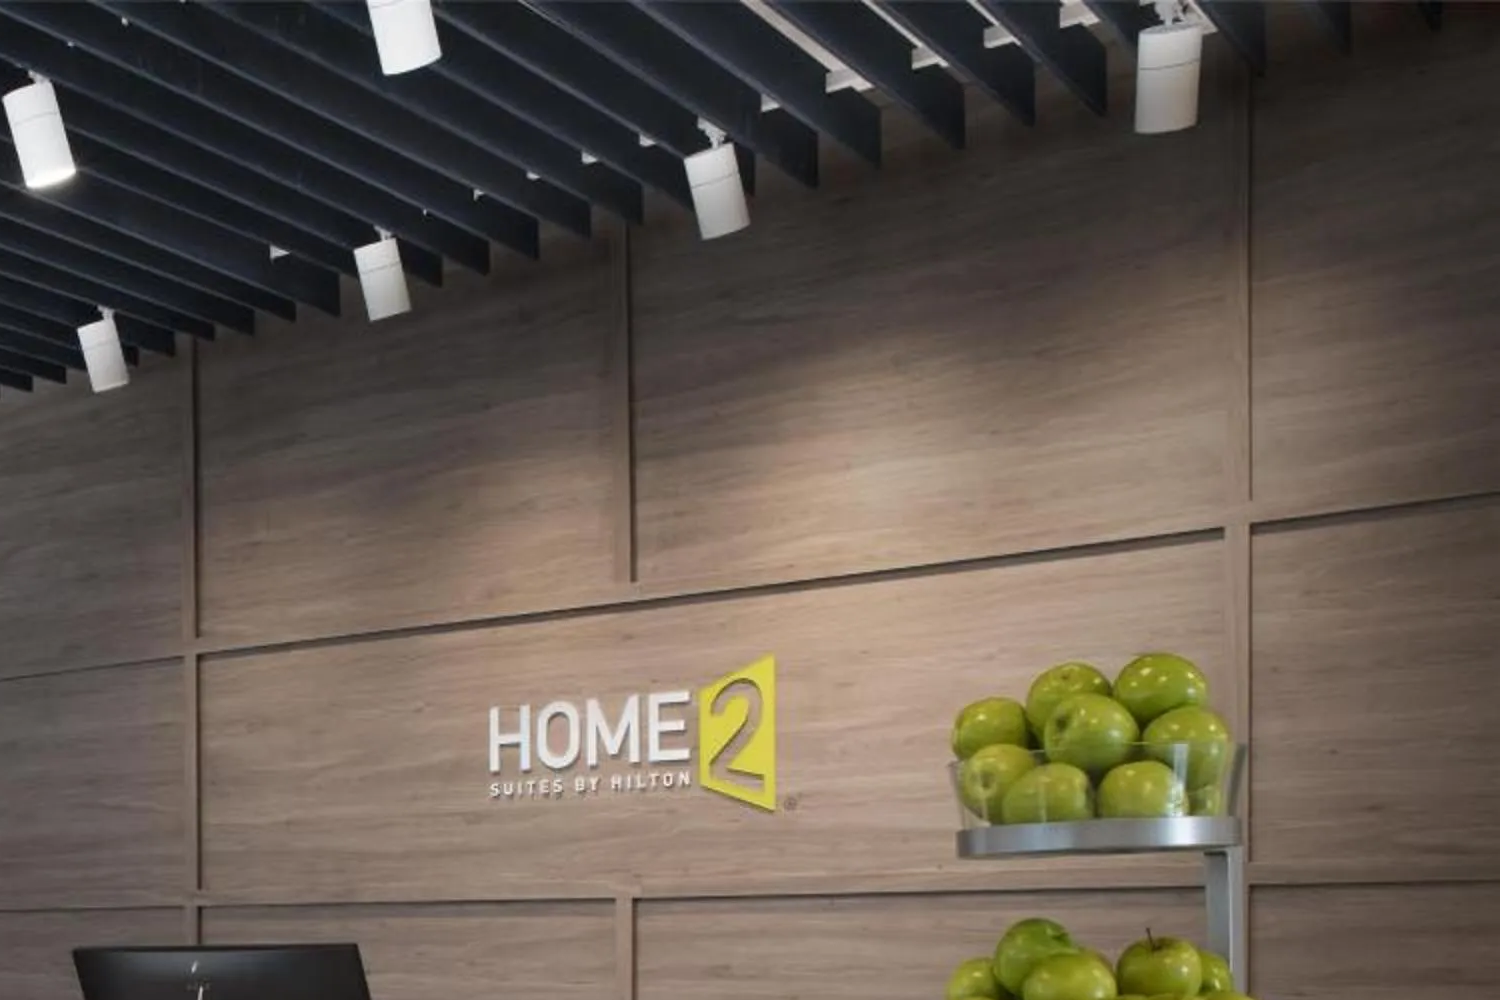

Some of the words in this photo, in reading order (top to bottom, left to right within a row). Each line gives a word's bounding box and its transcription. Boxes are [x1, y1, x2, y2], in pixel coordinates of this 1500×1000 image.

[489, 689, 691, 773] HOME
[709, 677, 765, 793] 2
[489, 779, 564, 797] SUITES
[574, 775, 601, 792] BY
[610, 771, 691, 790] HILTON
